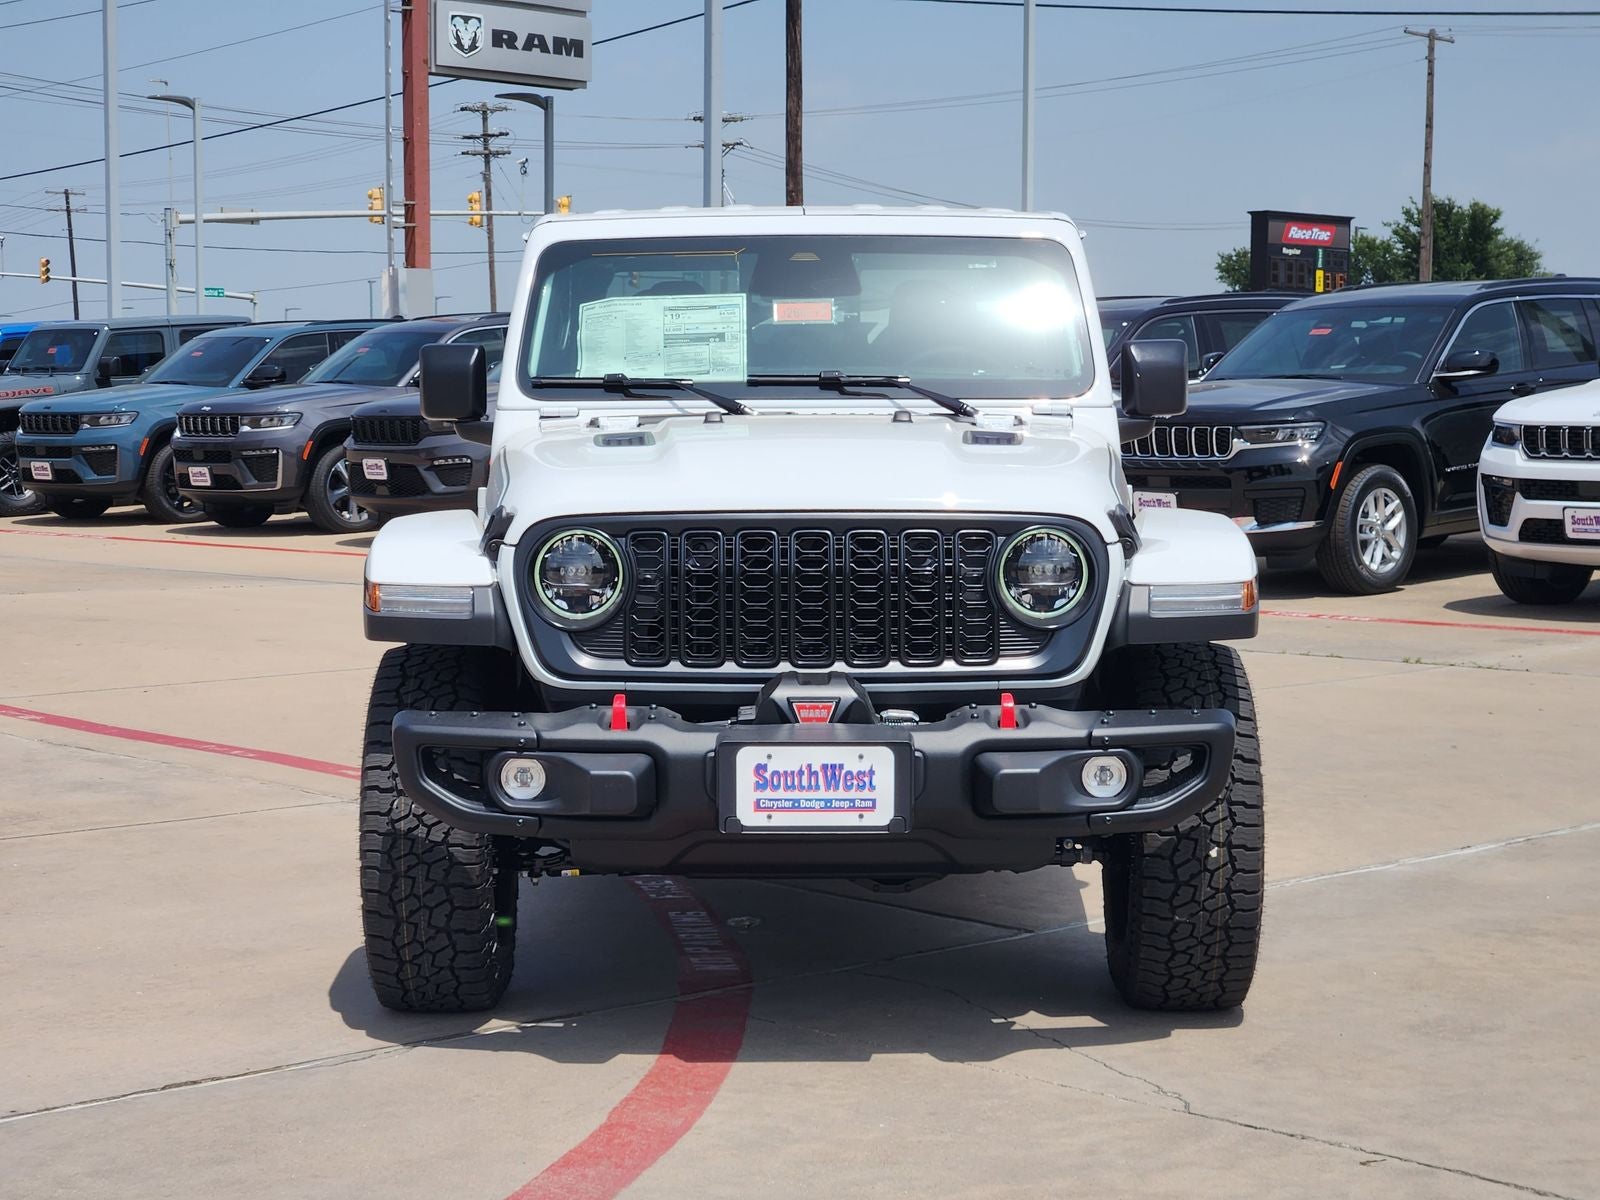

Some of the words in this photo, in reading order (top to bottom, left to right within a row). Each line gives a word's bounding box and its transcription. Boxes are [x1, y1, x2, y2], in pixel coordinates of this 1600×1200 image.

[491, 29, 584, 58] RAM
[1289, 226, 1331, 241] RaceTrac
[0, 387, 53, 397] OJAVE
[1571, 515, 1600, 526] SouthW
[800, 709, 829, 717] WARN
[753, 763, 876, 792] SouthWest
[760, 799, 793, 808] Chrysler
[800, 799, 825, 809] Dodge
[832, 799, 850, 809] Jeep
[855, 799, 873, 808] Ram
